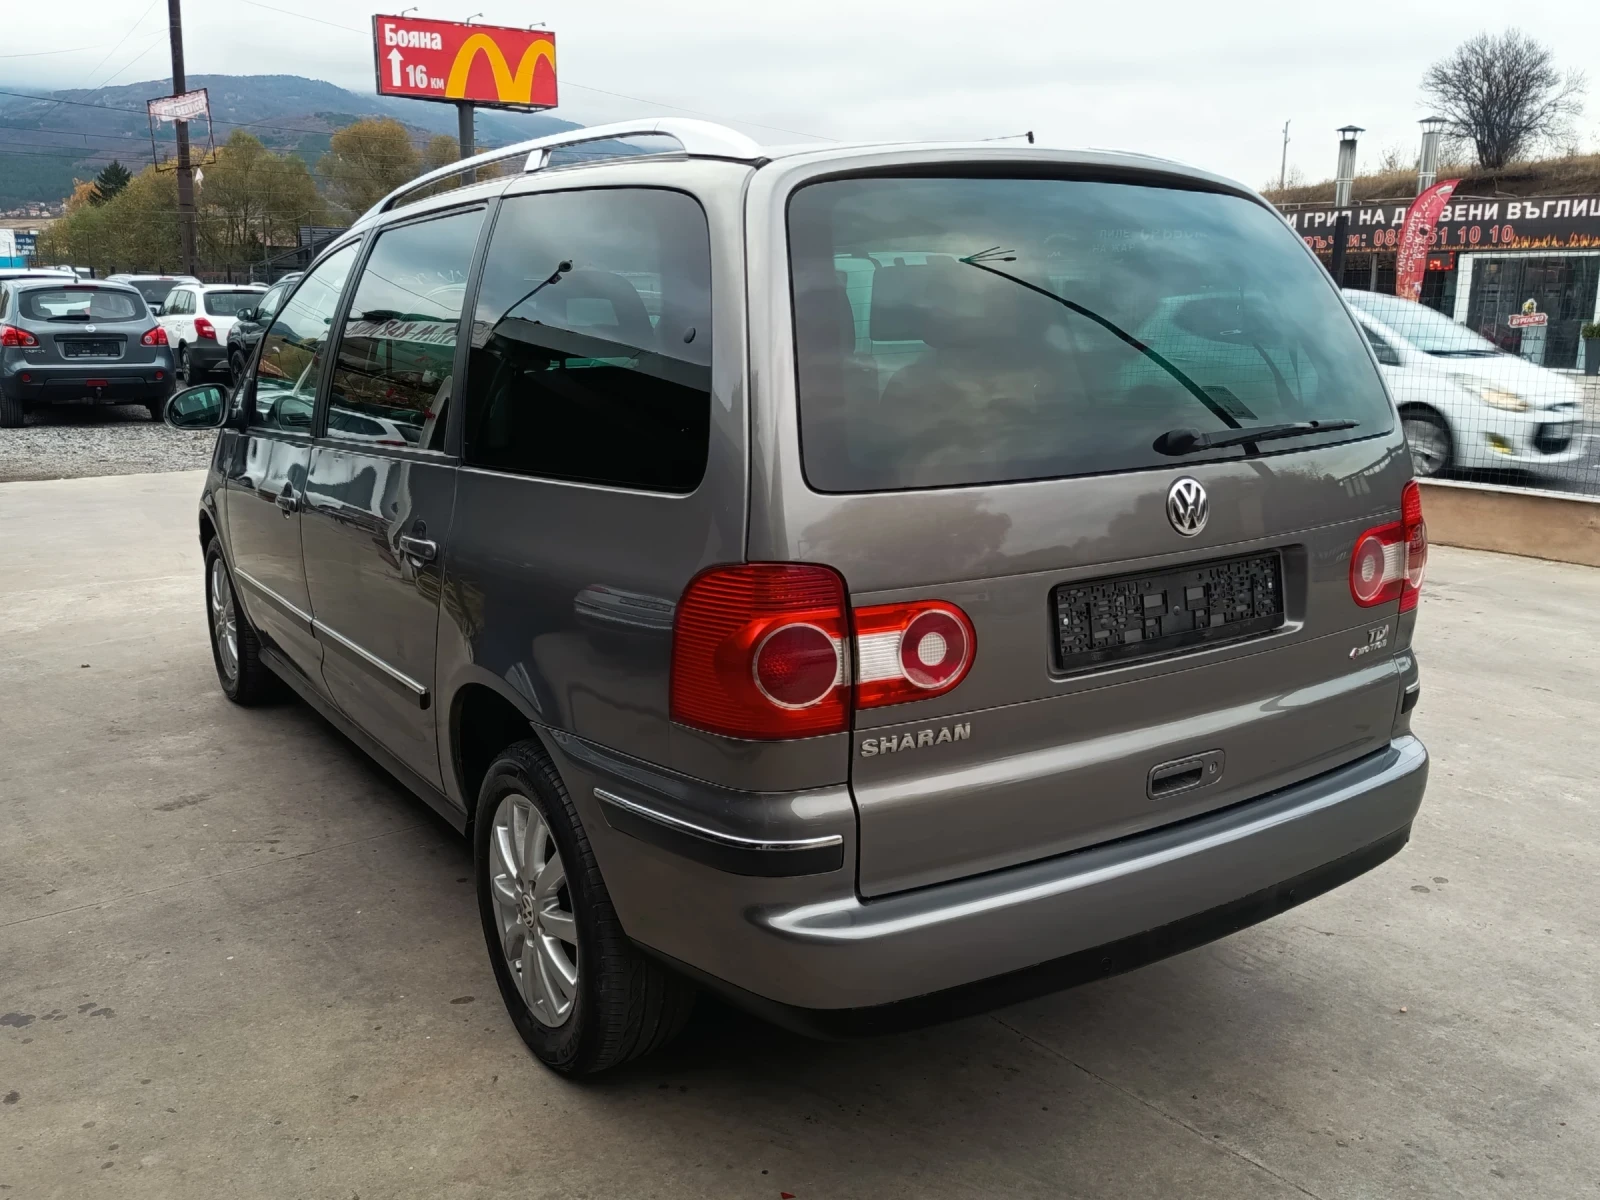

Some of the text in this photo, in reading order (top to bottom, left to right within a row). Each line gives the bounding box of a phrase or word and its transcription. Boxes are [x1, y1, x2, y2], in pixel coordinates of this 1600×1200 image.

[384, 23, 442, 50] Бояна
[405, 64, 427, 89] 16
[1359, 208, 1386, 226] НА
[1391, 203, 1499, 227] ДВЕНИ
[1457, 225, 1482, 245] 10
[1489, 224, 1514, 244] 10
[860, 722, 972, 757] SHARAN
